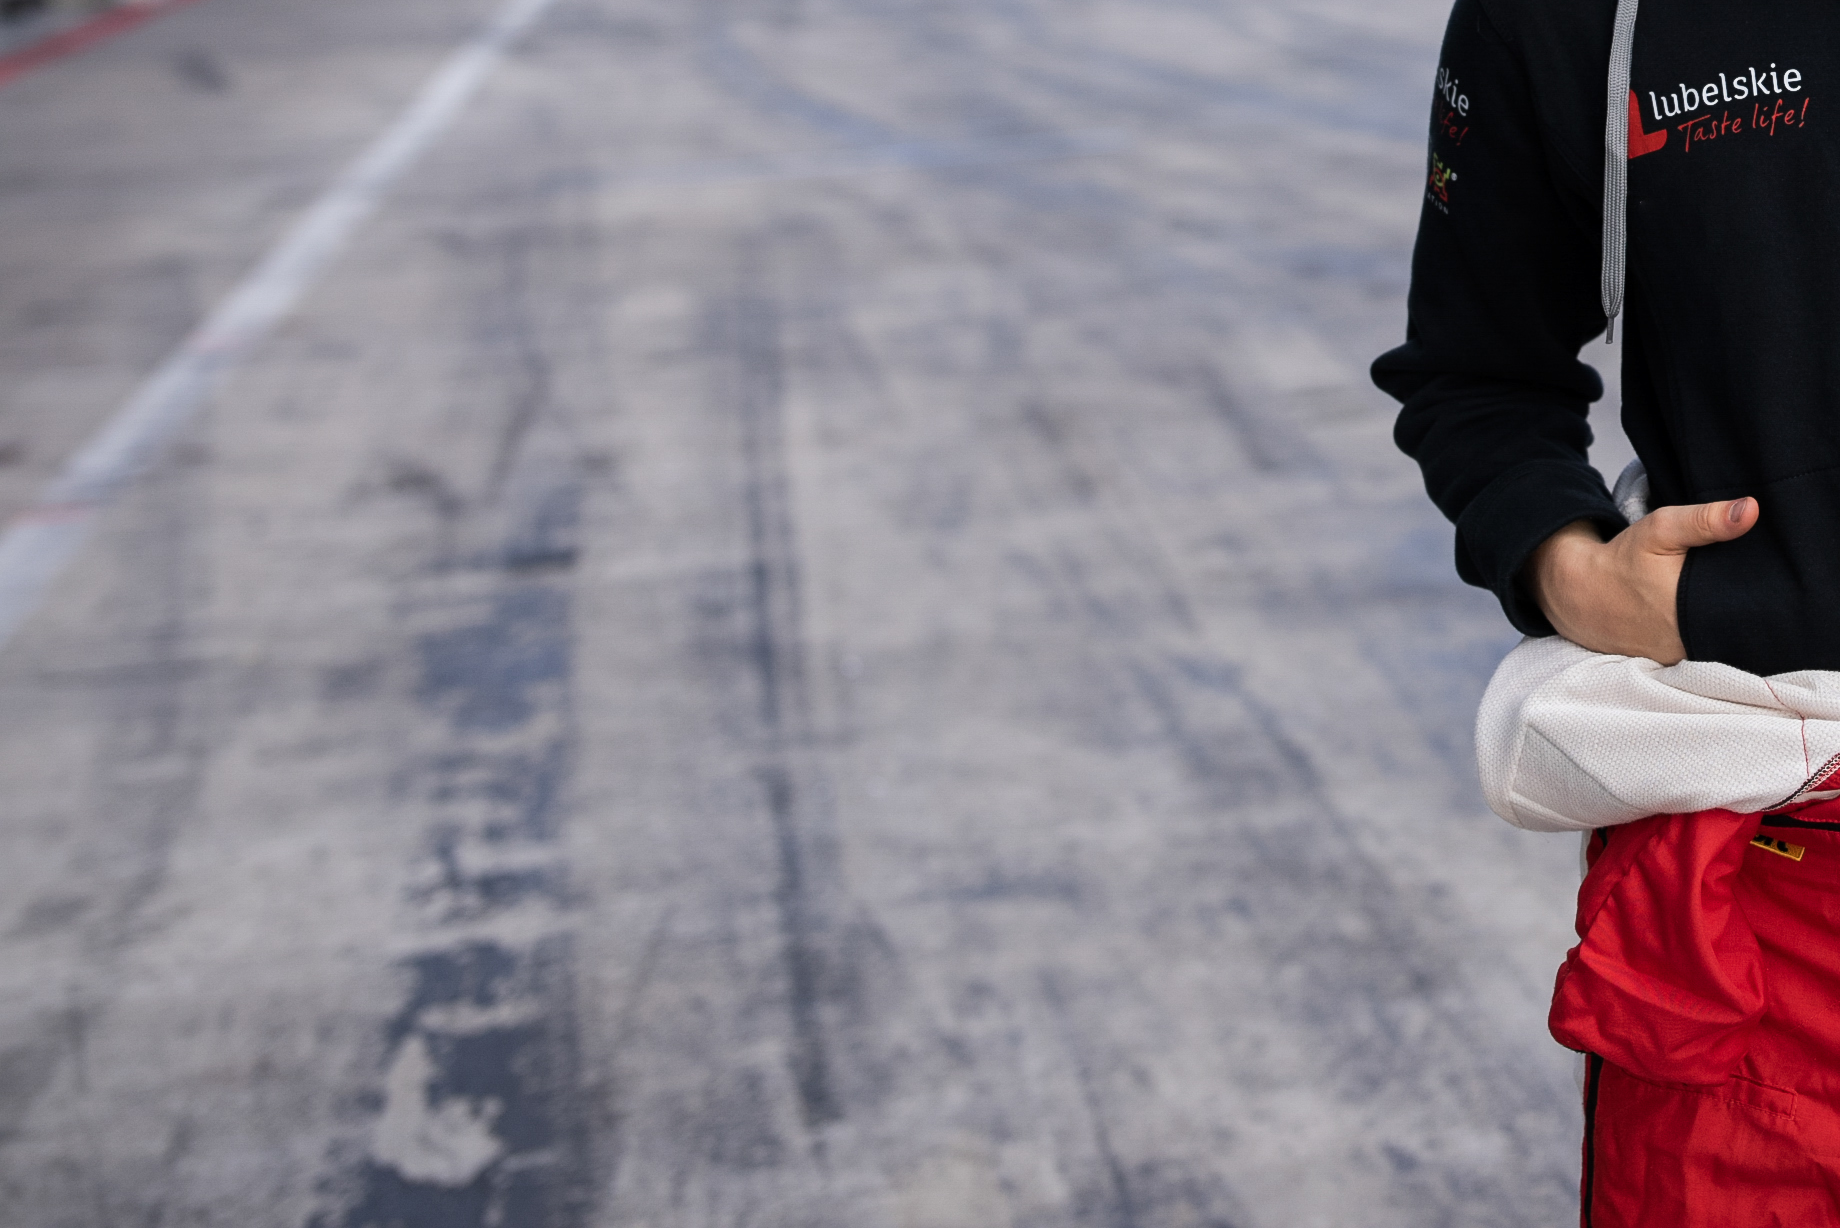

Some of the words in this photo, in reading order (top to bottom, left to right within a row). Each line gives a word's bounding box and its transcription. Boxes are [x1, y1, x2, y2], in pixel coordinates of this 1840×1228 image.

[1648, 62, 1802, 120] lubelskie
[1676, 110, 1742, 153] Taste
[1752, 97, 1810, 136] life!
